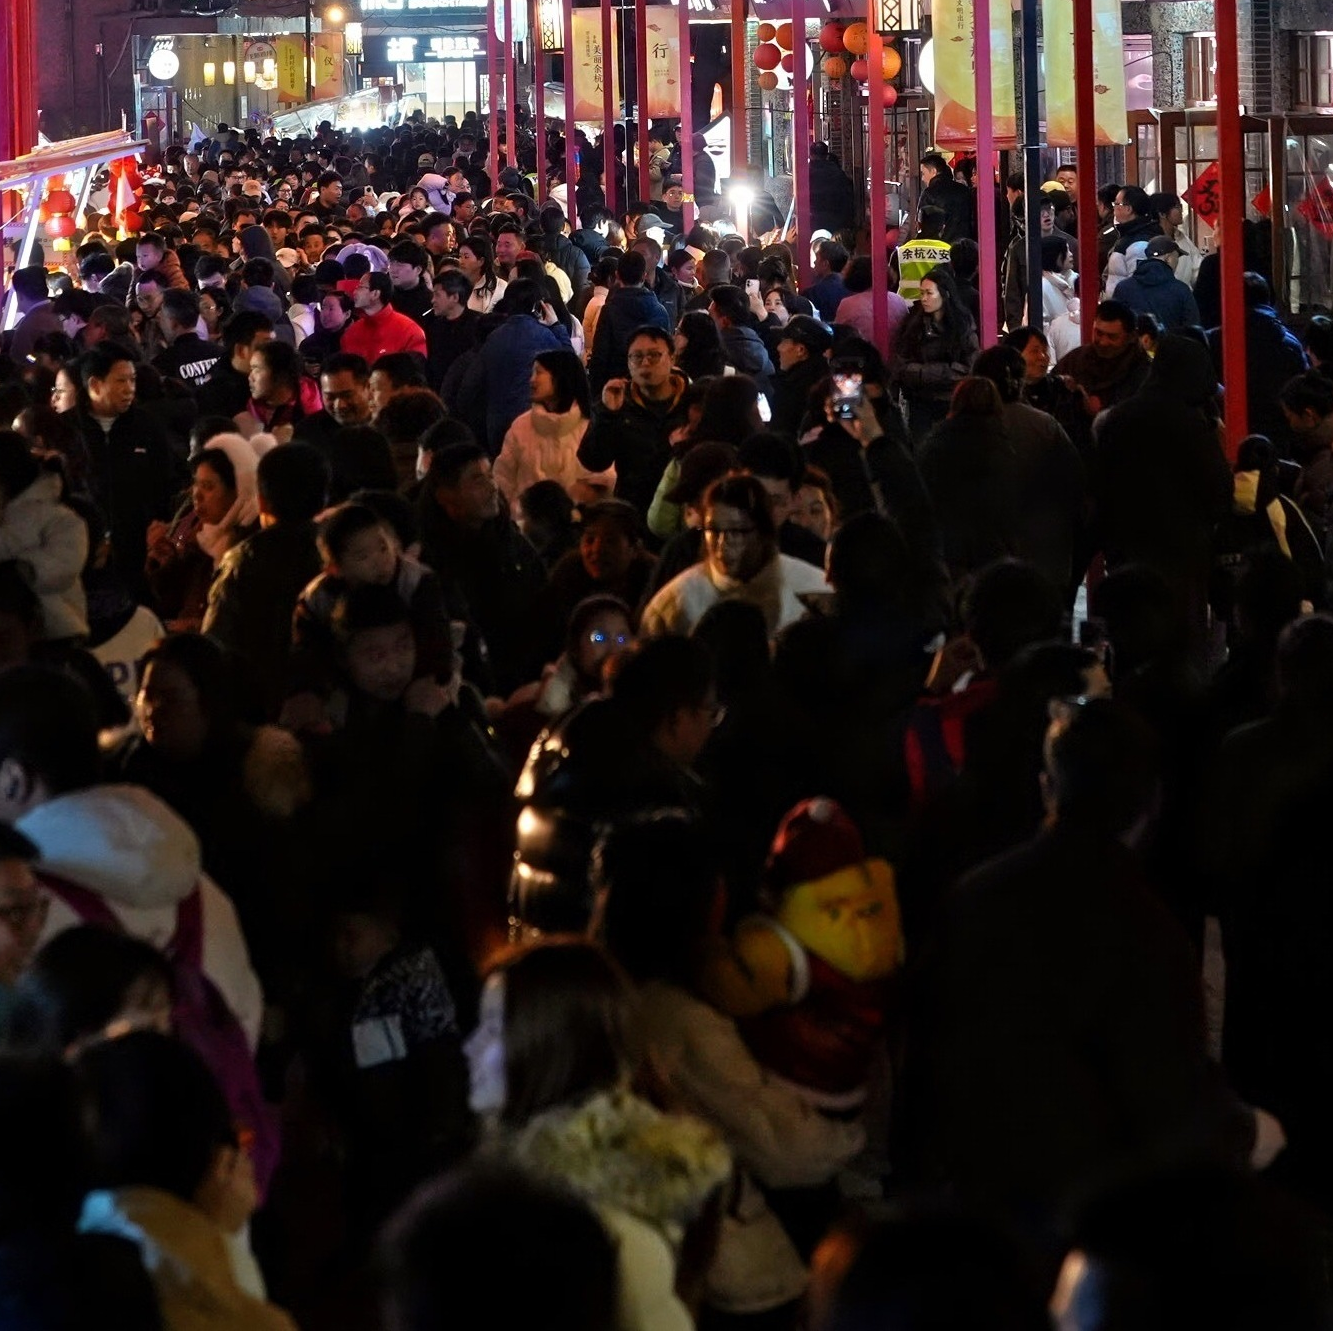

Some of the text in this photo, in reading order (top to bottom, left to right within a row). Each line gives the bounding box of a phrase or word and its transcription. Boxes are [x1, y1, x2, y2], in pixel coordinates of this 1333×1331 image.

[652, 42, 669, 59] 行
[323, 56, 334, 66] 仪
[902, 248, 950, 260] 余杭公安
